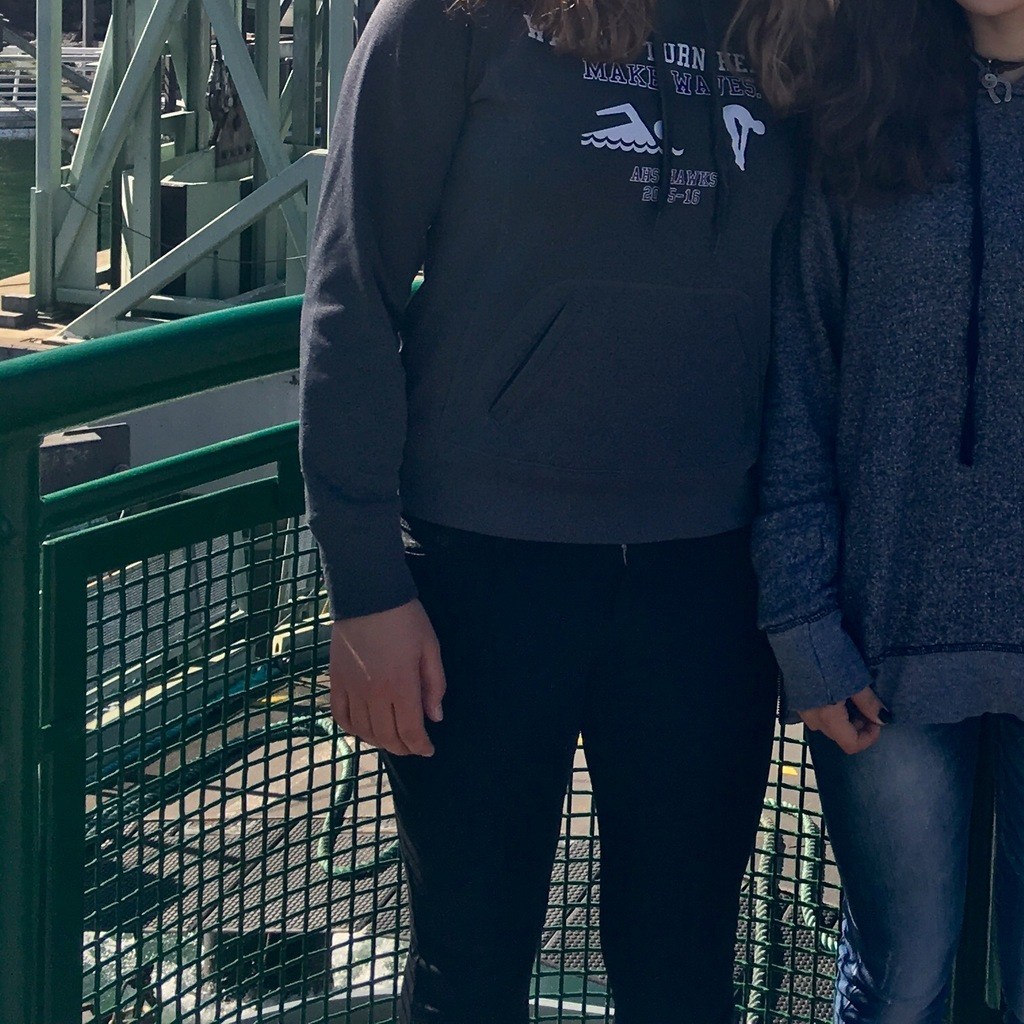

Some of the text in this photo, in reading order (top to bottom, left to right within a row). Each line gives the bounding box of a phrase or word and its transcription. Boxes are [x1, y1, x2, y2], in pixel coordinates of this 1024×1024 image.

[582, 58, 660, 91] MAKE
[629, 165, 660, 184] AHS
[641, 185, 701, 206] 205-16
